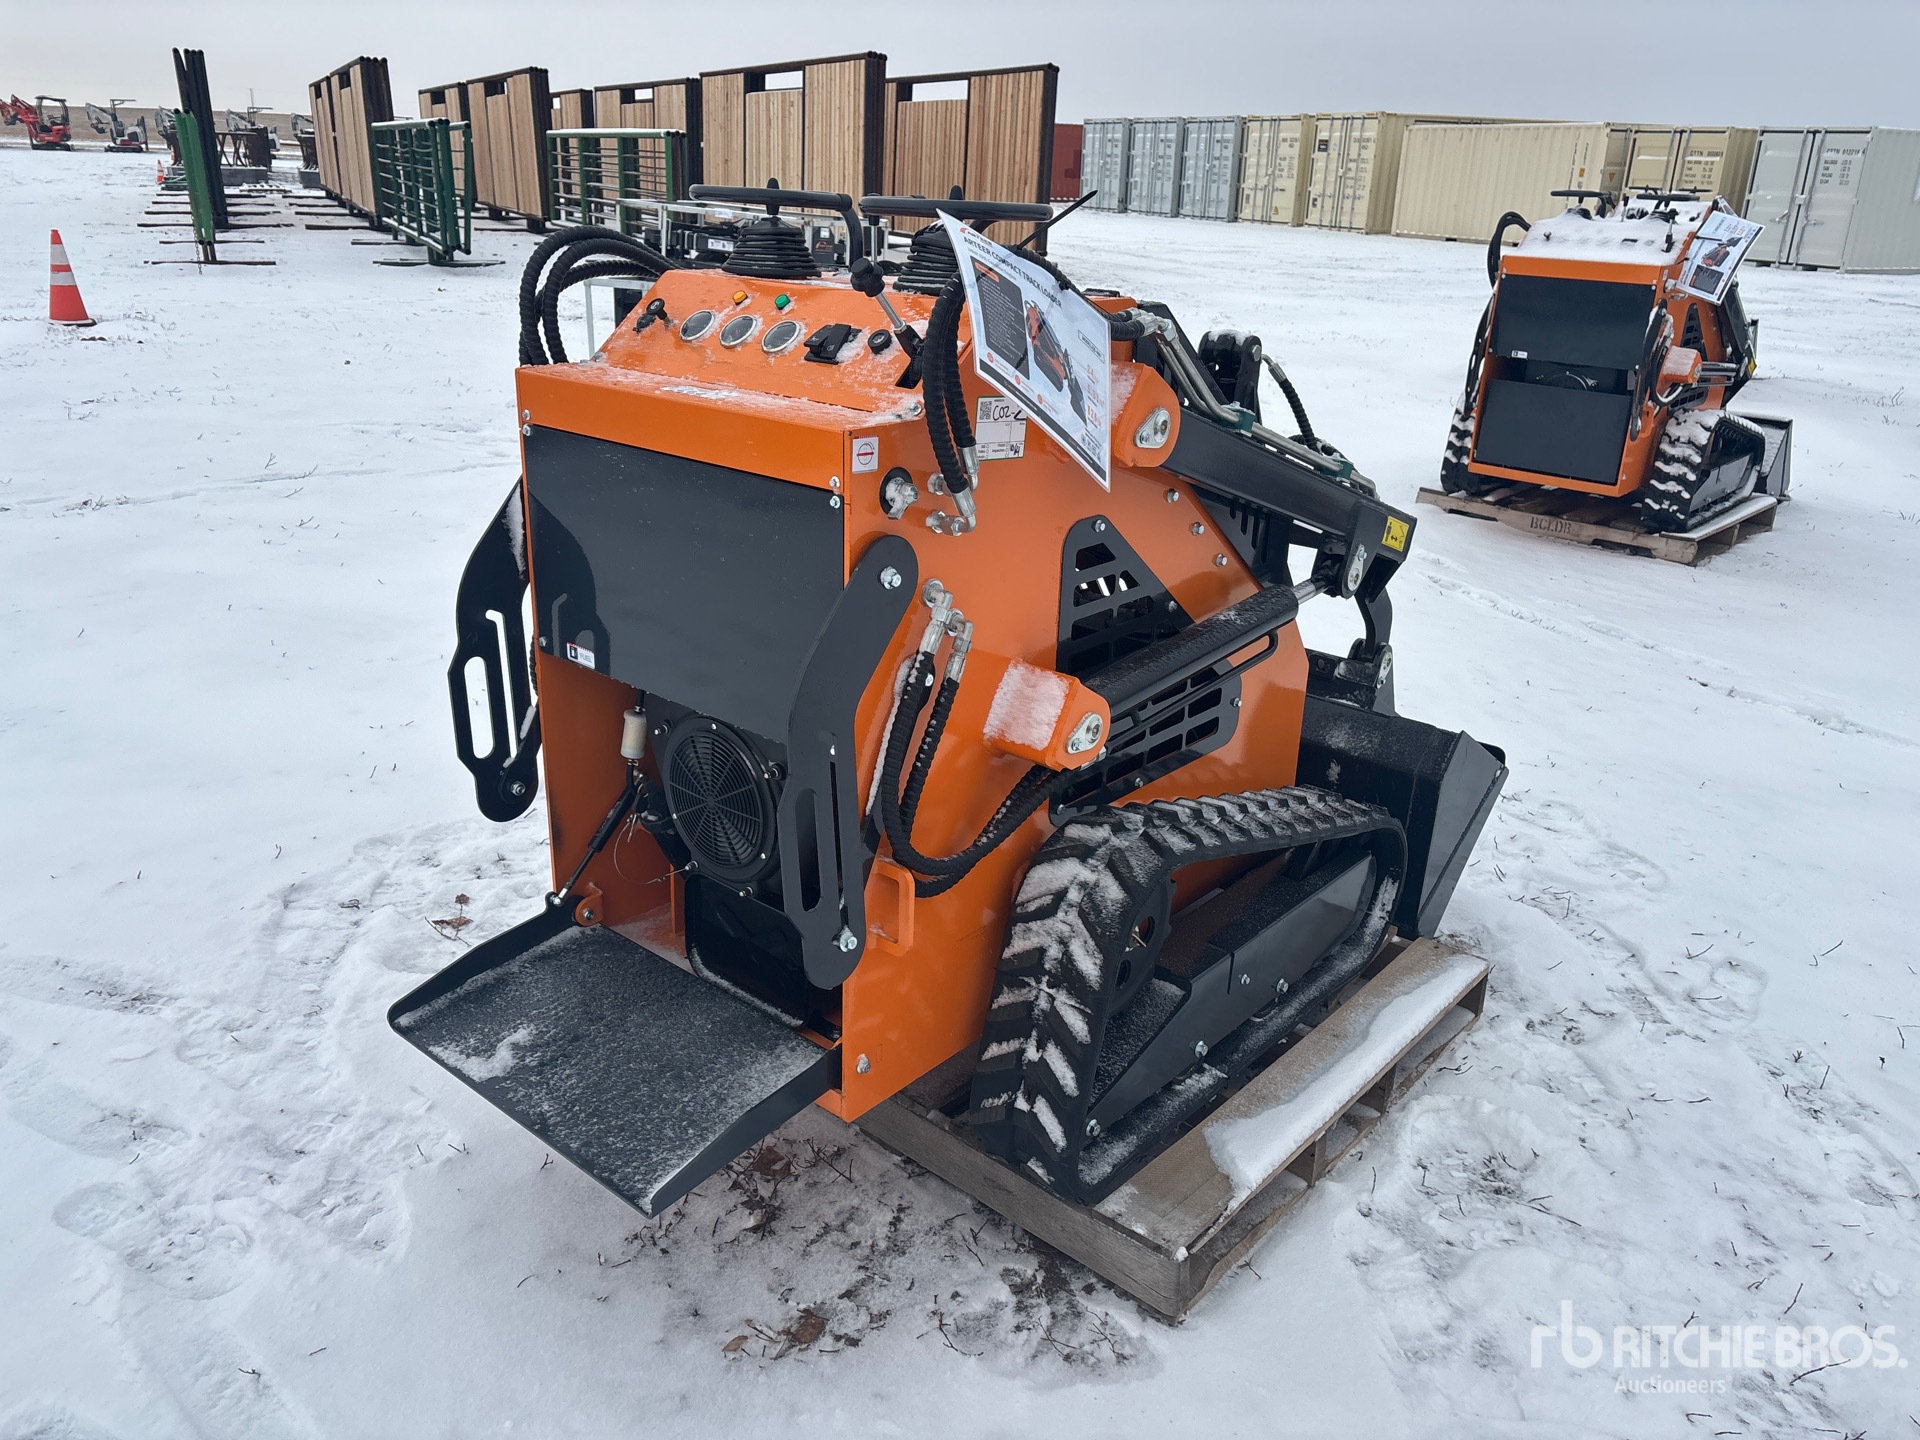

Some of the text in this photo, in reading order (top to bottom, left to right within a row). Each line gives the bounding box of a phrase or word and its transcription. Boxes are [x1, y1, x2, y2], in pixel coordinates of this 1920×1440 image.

[963, 236, 991, 257] ARTEER
[991, 250, 1022, 276] COMPACT
[1022, 271, 1042, 291] TRACK
[1041, 287, 1063, 307] LOADER
[579, 652, 592, 663] FUEL
